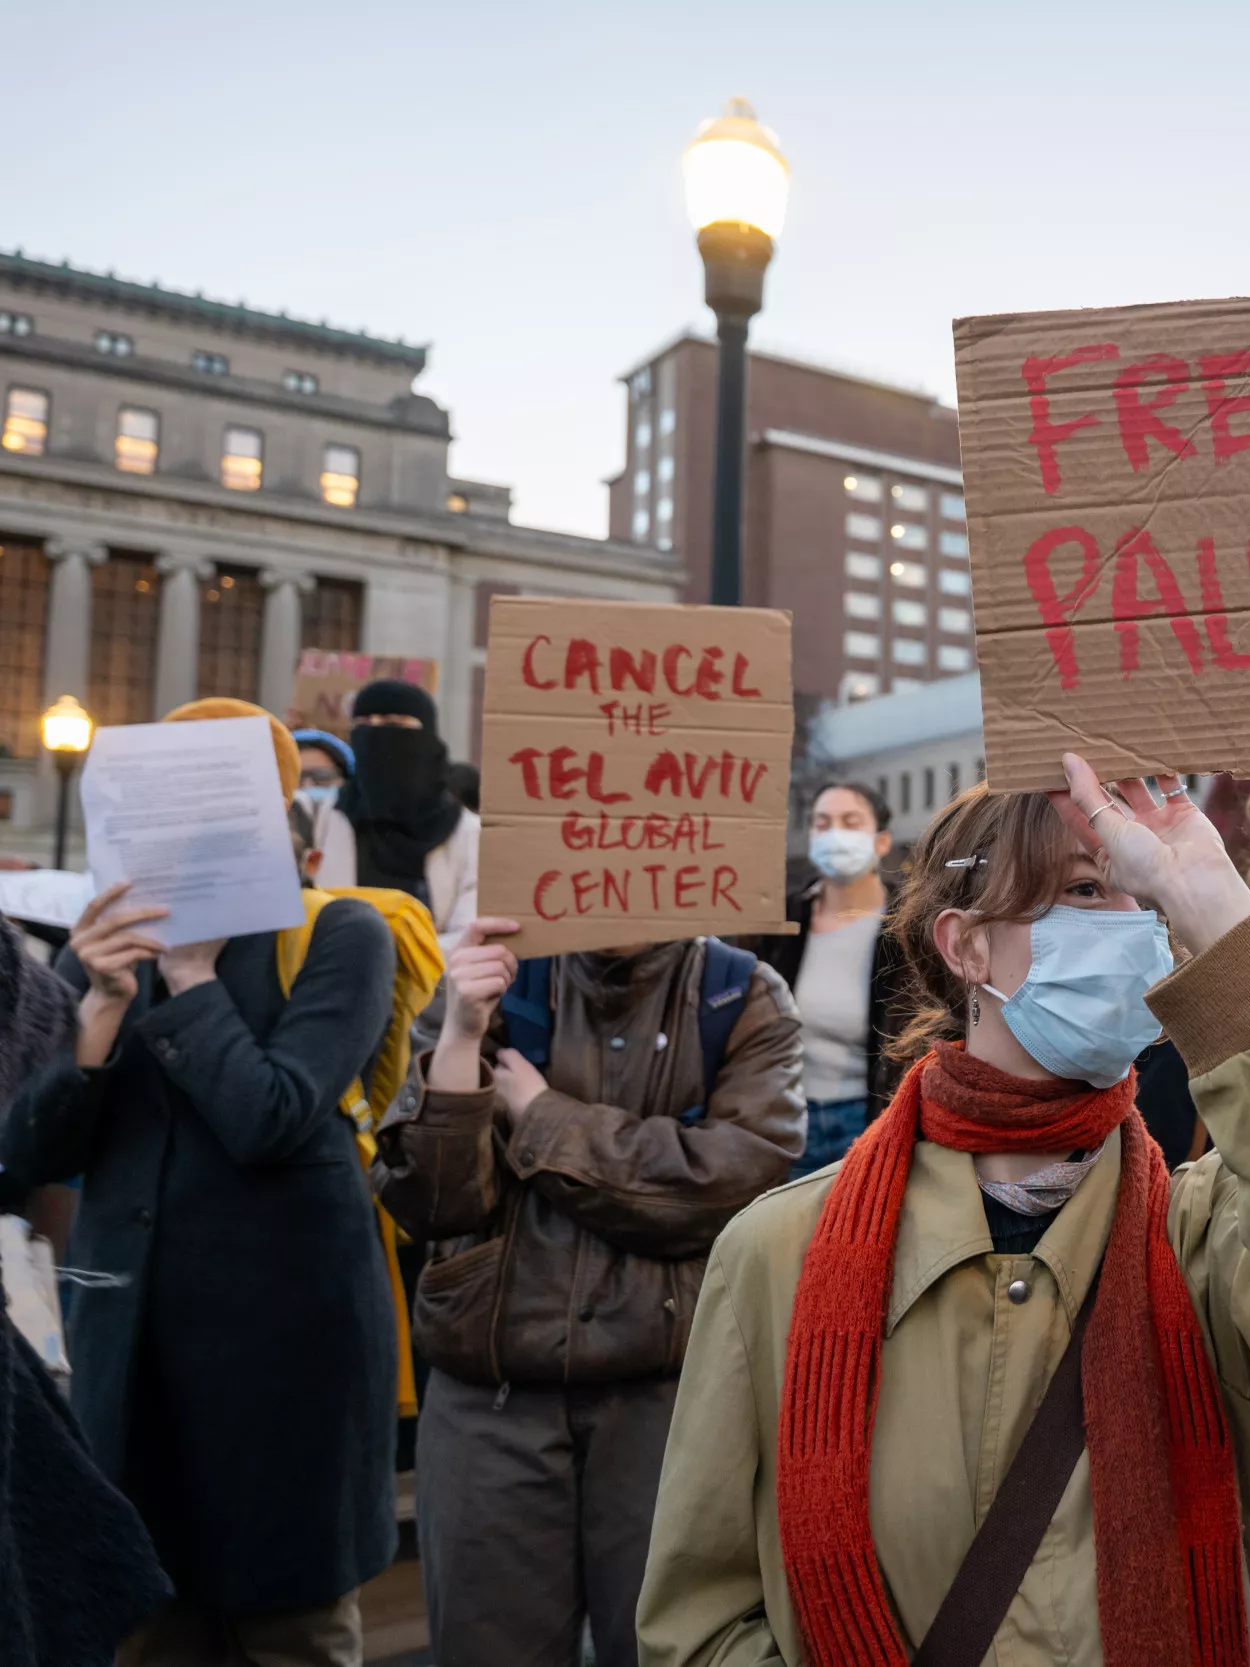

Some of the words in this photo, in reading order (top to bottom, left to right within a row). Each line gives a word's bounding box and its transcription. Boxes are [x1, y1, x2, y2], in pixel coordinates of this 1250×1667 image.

[522, 635, 761, 701] CANCEL
[600, 700, 671, 736] THE
[508, 746, 632, 805] TEL
[644, 750, 767, 803] AVIV
[561, 811, 724, 852] GLOBAL
[533, 864, 741, 921] CENTER
